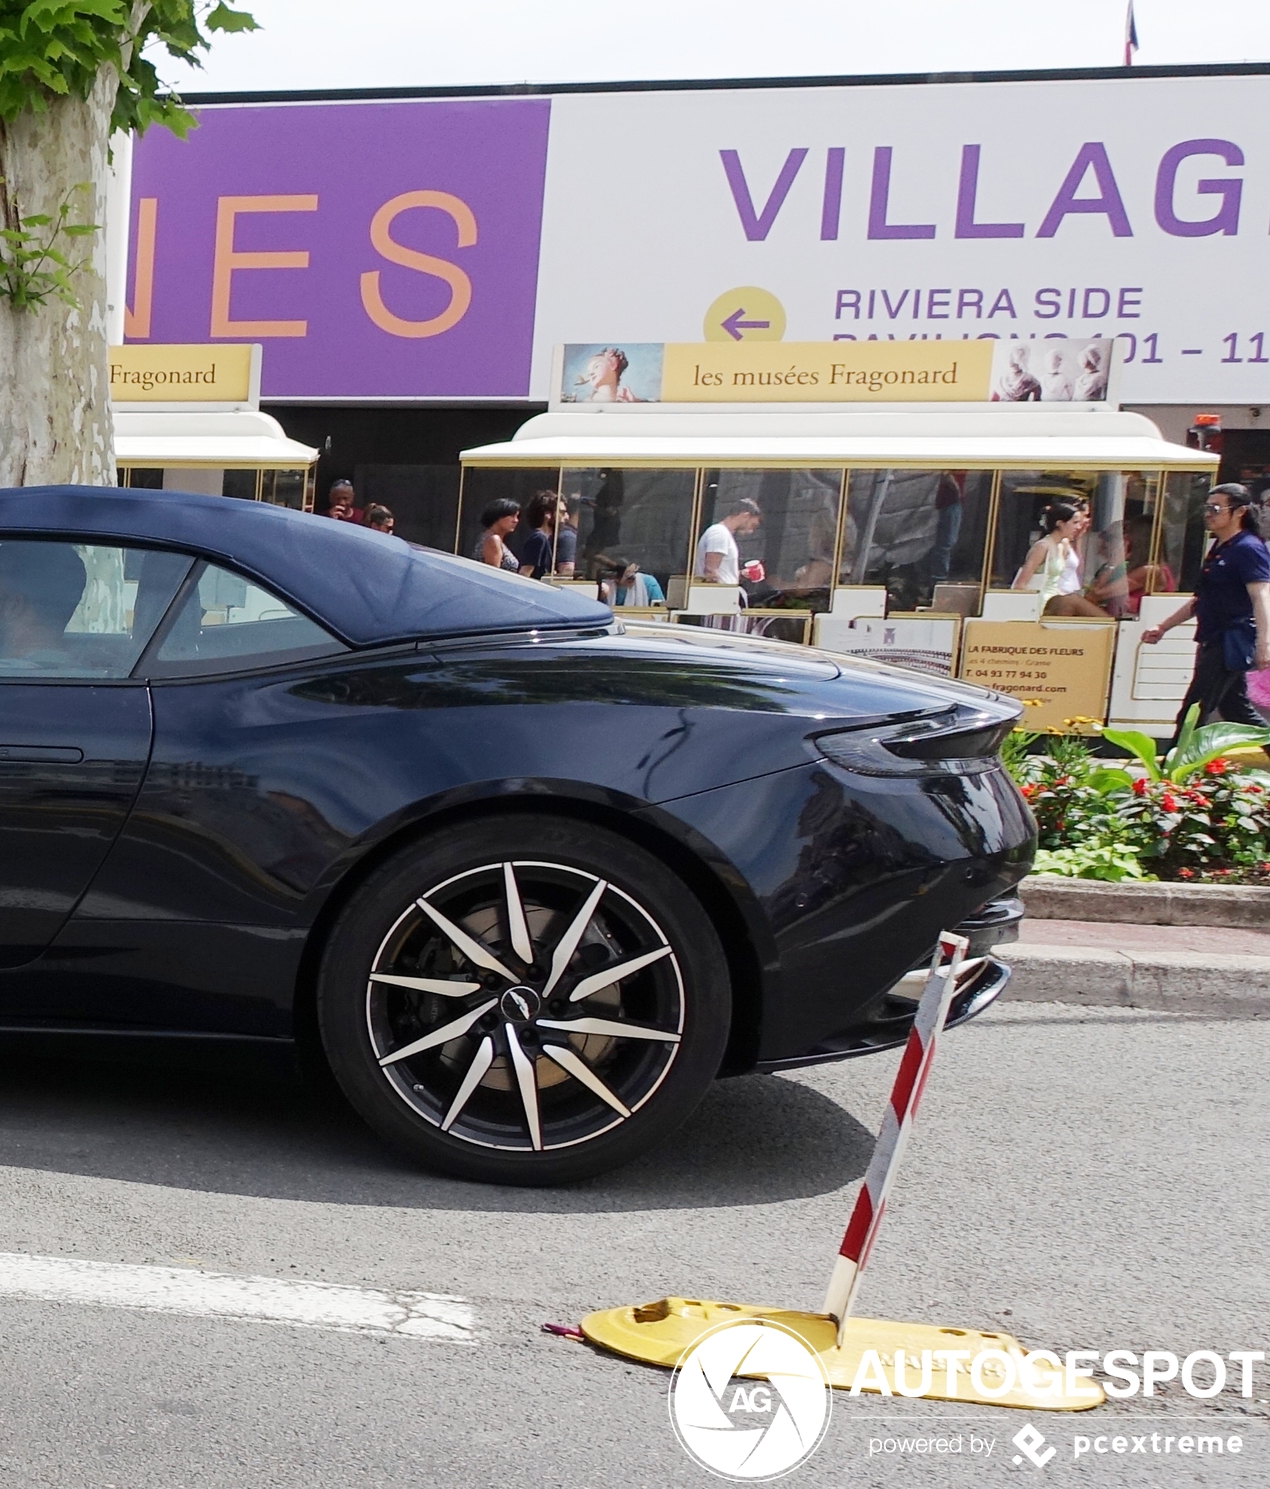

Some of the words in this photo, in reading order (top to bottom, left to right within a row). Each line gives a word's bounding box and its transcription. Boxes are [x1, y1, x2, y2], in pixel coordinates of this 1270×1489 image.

[719, 137, 1270, 241] VILLAG
[834, 288, 1018, 320] RIVIERA
[1033, 287, 1144, 319] SIDE
[110, 363, 216, 391] Fragonard
[693, 364, 723, 386] les
[732, 364, 820, 386] musées
[828, 362, 958, 392] Fragonard
[981, 646, 1027, 656] FABRIQUE
[1029, 647, 1047, 655] DES
[1050, 648, 1084, 656] FLEURS
[990, 670, 1002, 678] 93
[1005, 670, 1017, 678] 77
[1019, 671, 1032, 679] 94
[1034, 671, 1047, 679] 30
